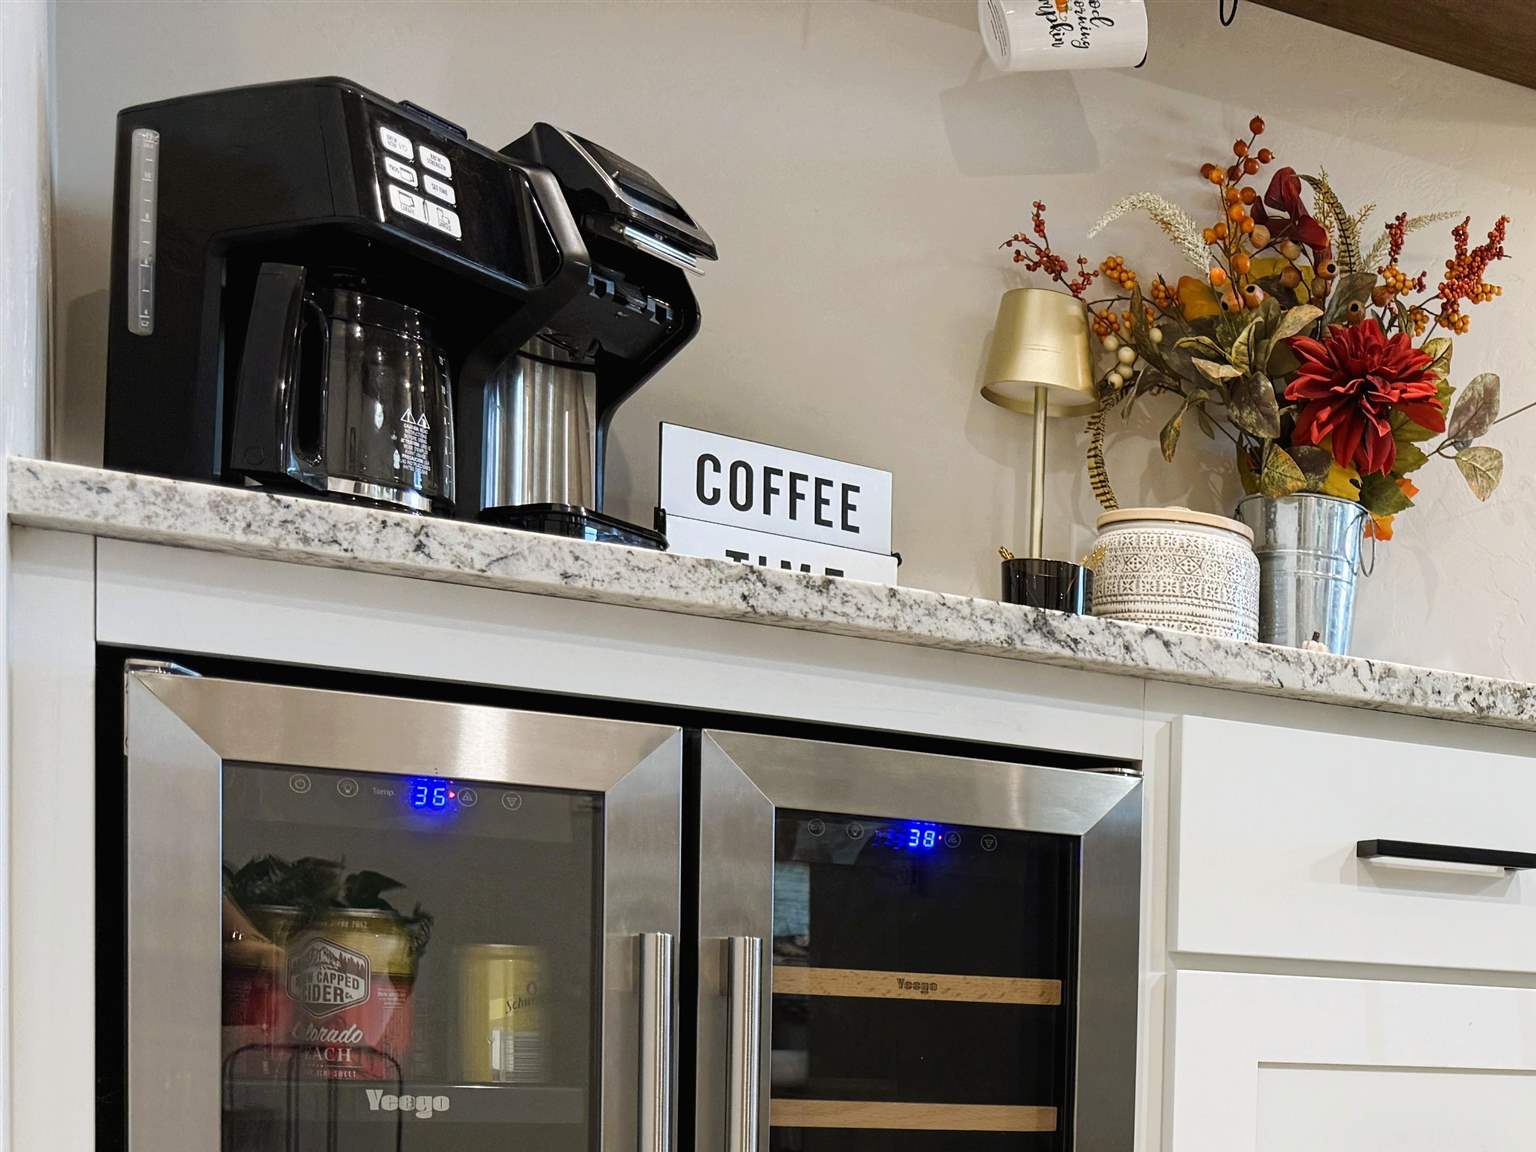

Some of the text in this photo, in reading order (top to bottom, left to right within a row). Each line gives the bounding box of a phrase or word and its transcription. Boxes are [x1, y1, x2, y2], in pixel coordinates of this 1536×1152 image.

[1035, 0, 1074, 48] mpkin
[1071, 0, 1091, 49] orning
[696, 452, 860, 534] COFFEE
[415, 786, 446, 806] 36
[908, 828, 936, 847] 38
[316, 971, 360, 990] CAPPED
[365, 1088, 450, 1119] Yeego
